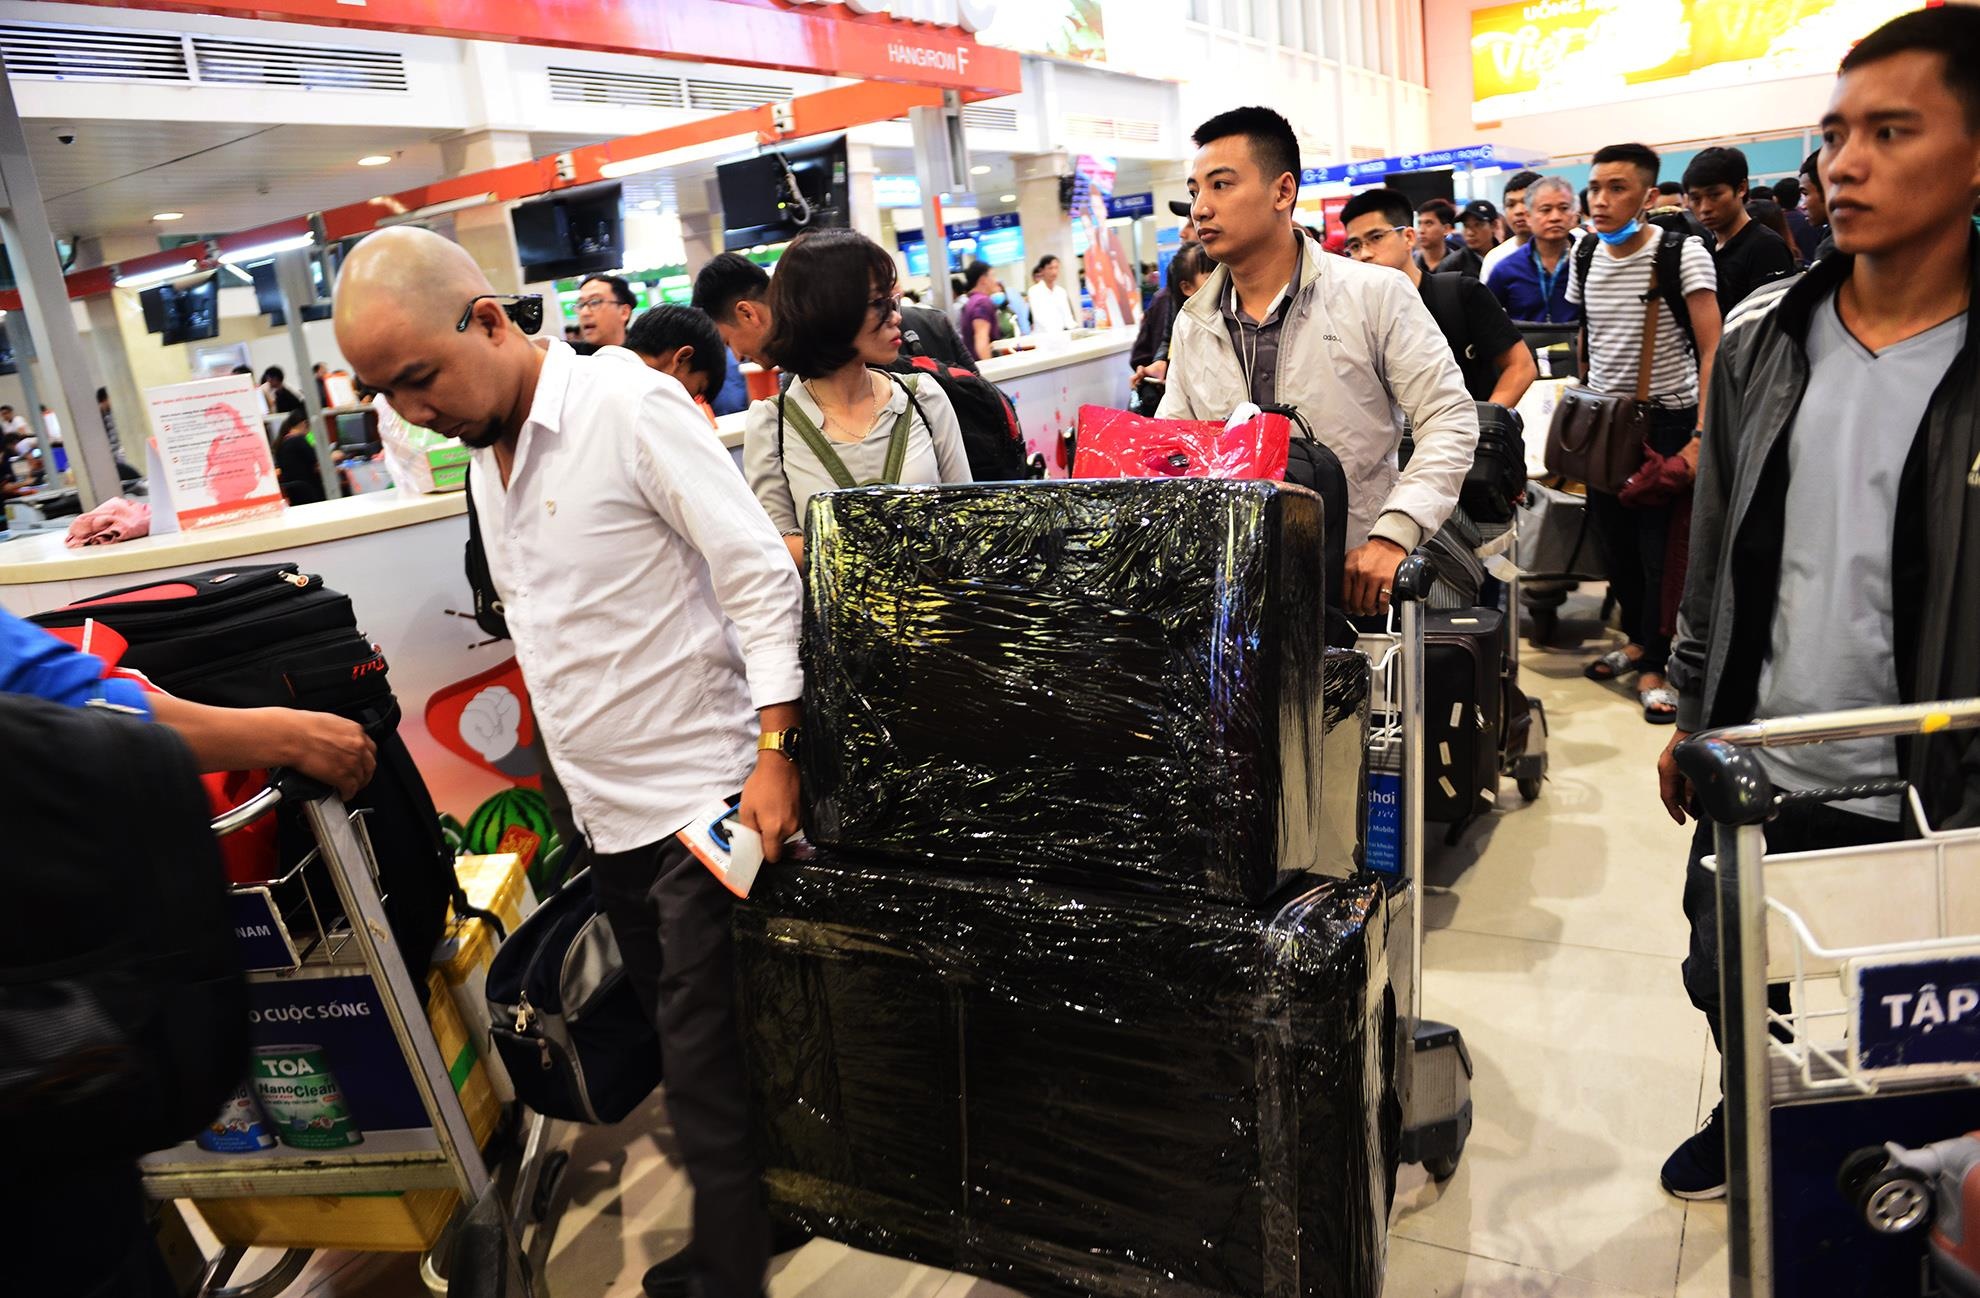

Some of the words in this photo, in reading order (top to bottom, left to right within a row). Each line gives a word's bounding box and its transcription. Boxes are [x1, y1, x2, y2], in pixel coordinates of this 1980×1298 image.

[957, 46, 969, 75] F
[1302, 167, 1328, 183] G-2
[264, 1004, 315, 1025] CUỘC
[317, 1000, 371, 1019] SỐNG
[1880, 983, 1979, 1034] TẬP
[262, 1058, 315, 1077] TOA
